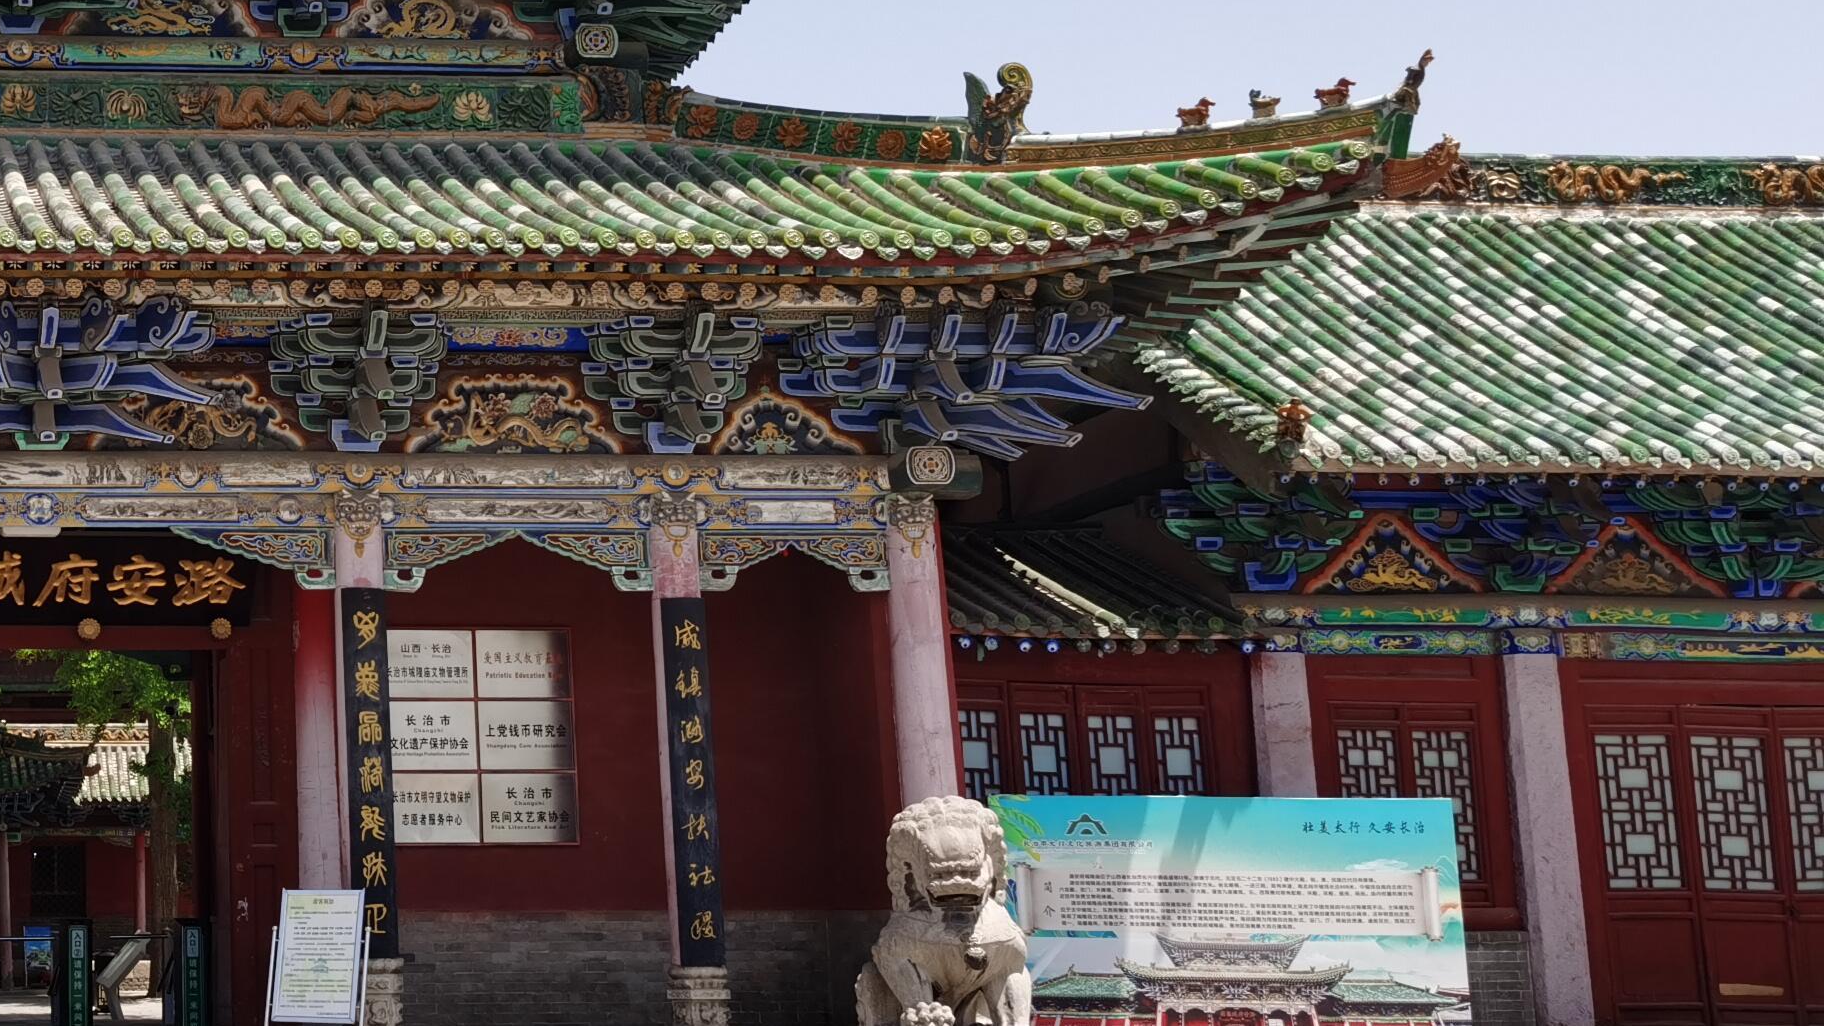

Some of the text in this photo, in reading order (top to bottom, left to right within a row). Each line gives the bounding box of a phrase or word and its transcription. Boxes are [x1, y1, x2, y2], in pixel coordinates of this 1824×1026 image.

[515, 671, 546, 679] Education
[405, 714, 451, 727] 长治市
[485, 723, 567, 738] 上党钱币研究会
[390, 737, 469, 750] 文化遗产保护协会
[505, 786, 553, 799] 长治市
[401, 813, 463, 826] 志愿者服务中心
[490, 810, 569, 823] 民间文艺家协会
[1302, 820, 1425, 835] 壮美太行 久安长治
